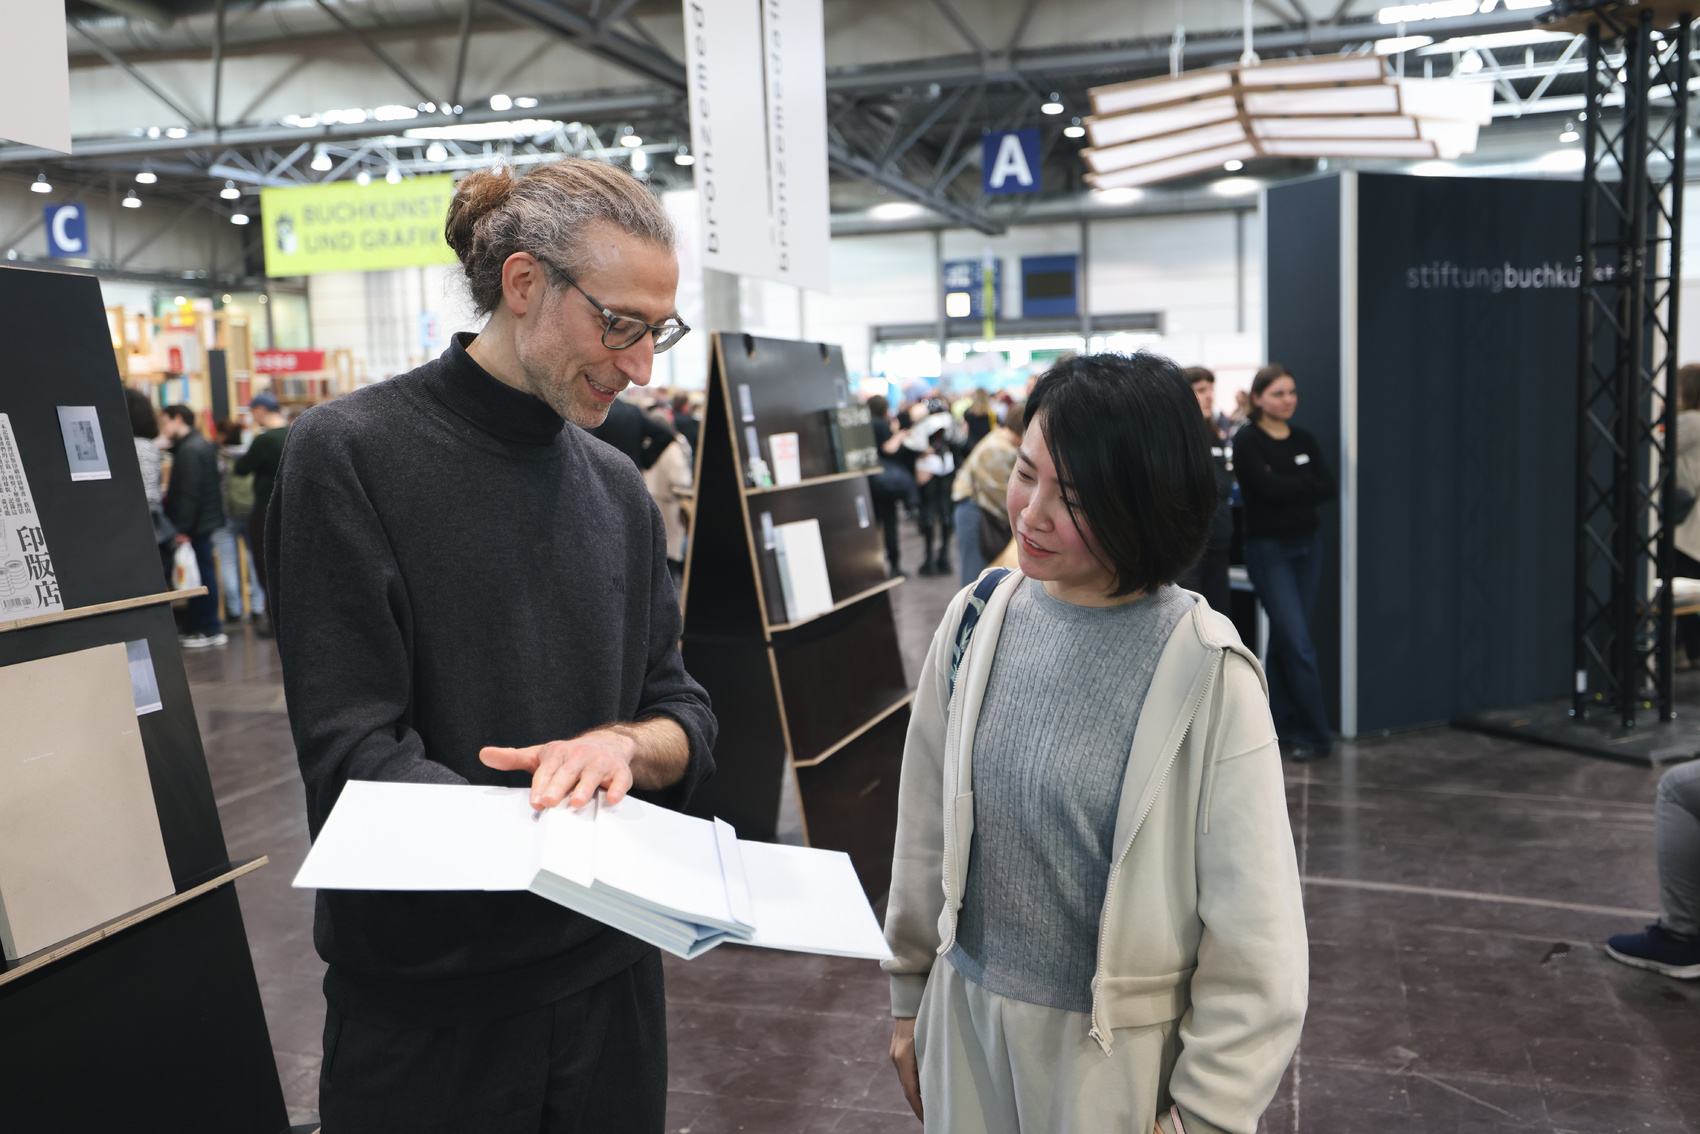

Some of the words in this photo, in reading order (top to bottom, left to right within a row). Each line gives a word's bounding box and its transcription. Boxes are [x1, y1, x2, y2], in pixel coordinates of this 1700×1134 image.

[989, 134, 1033, 188] A
[52, 205, 82, 253] C
[302, 195, 443, 226] BUCHKUNST
[304, 230, 355, 254] UND
[16, 525, 61, 608] 印版店
